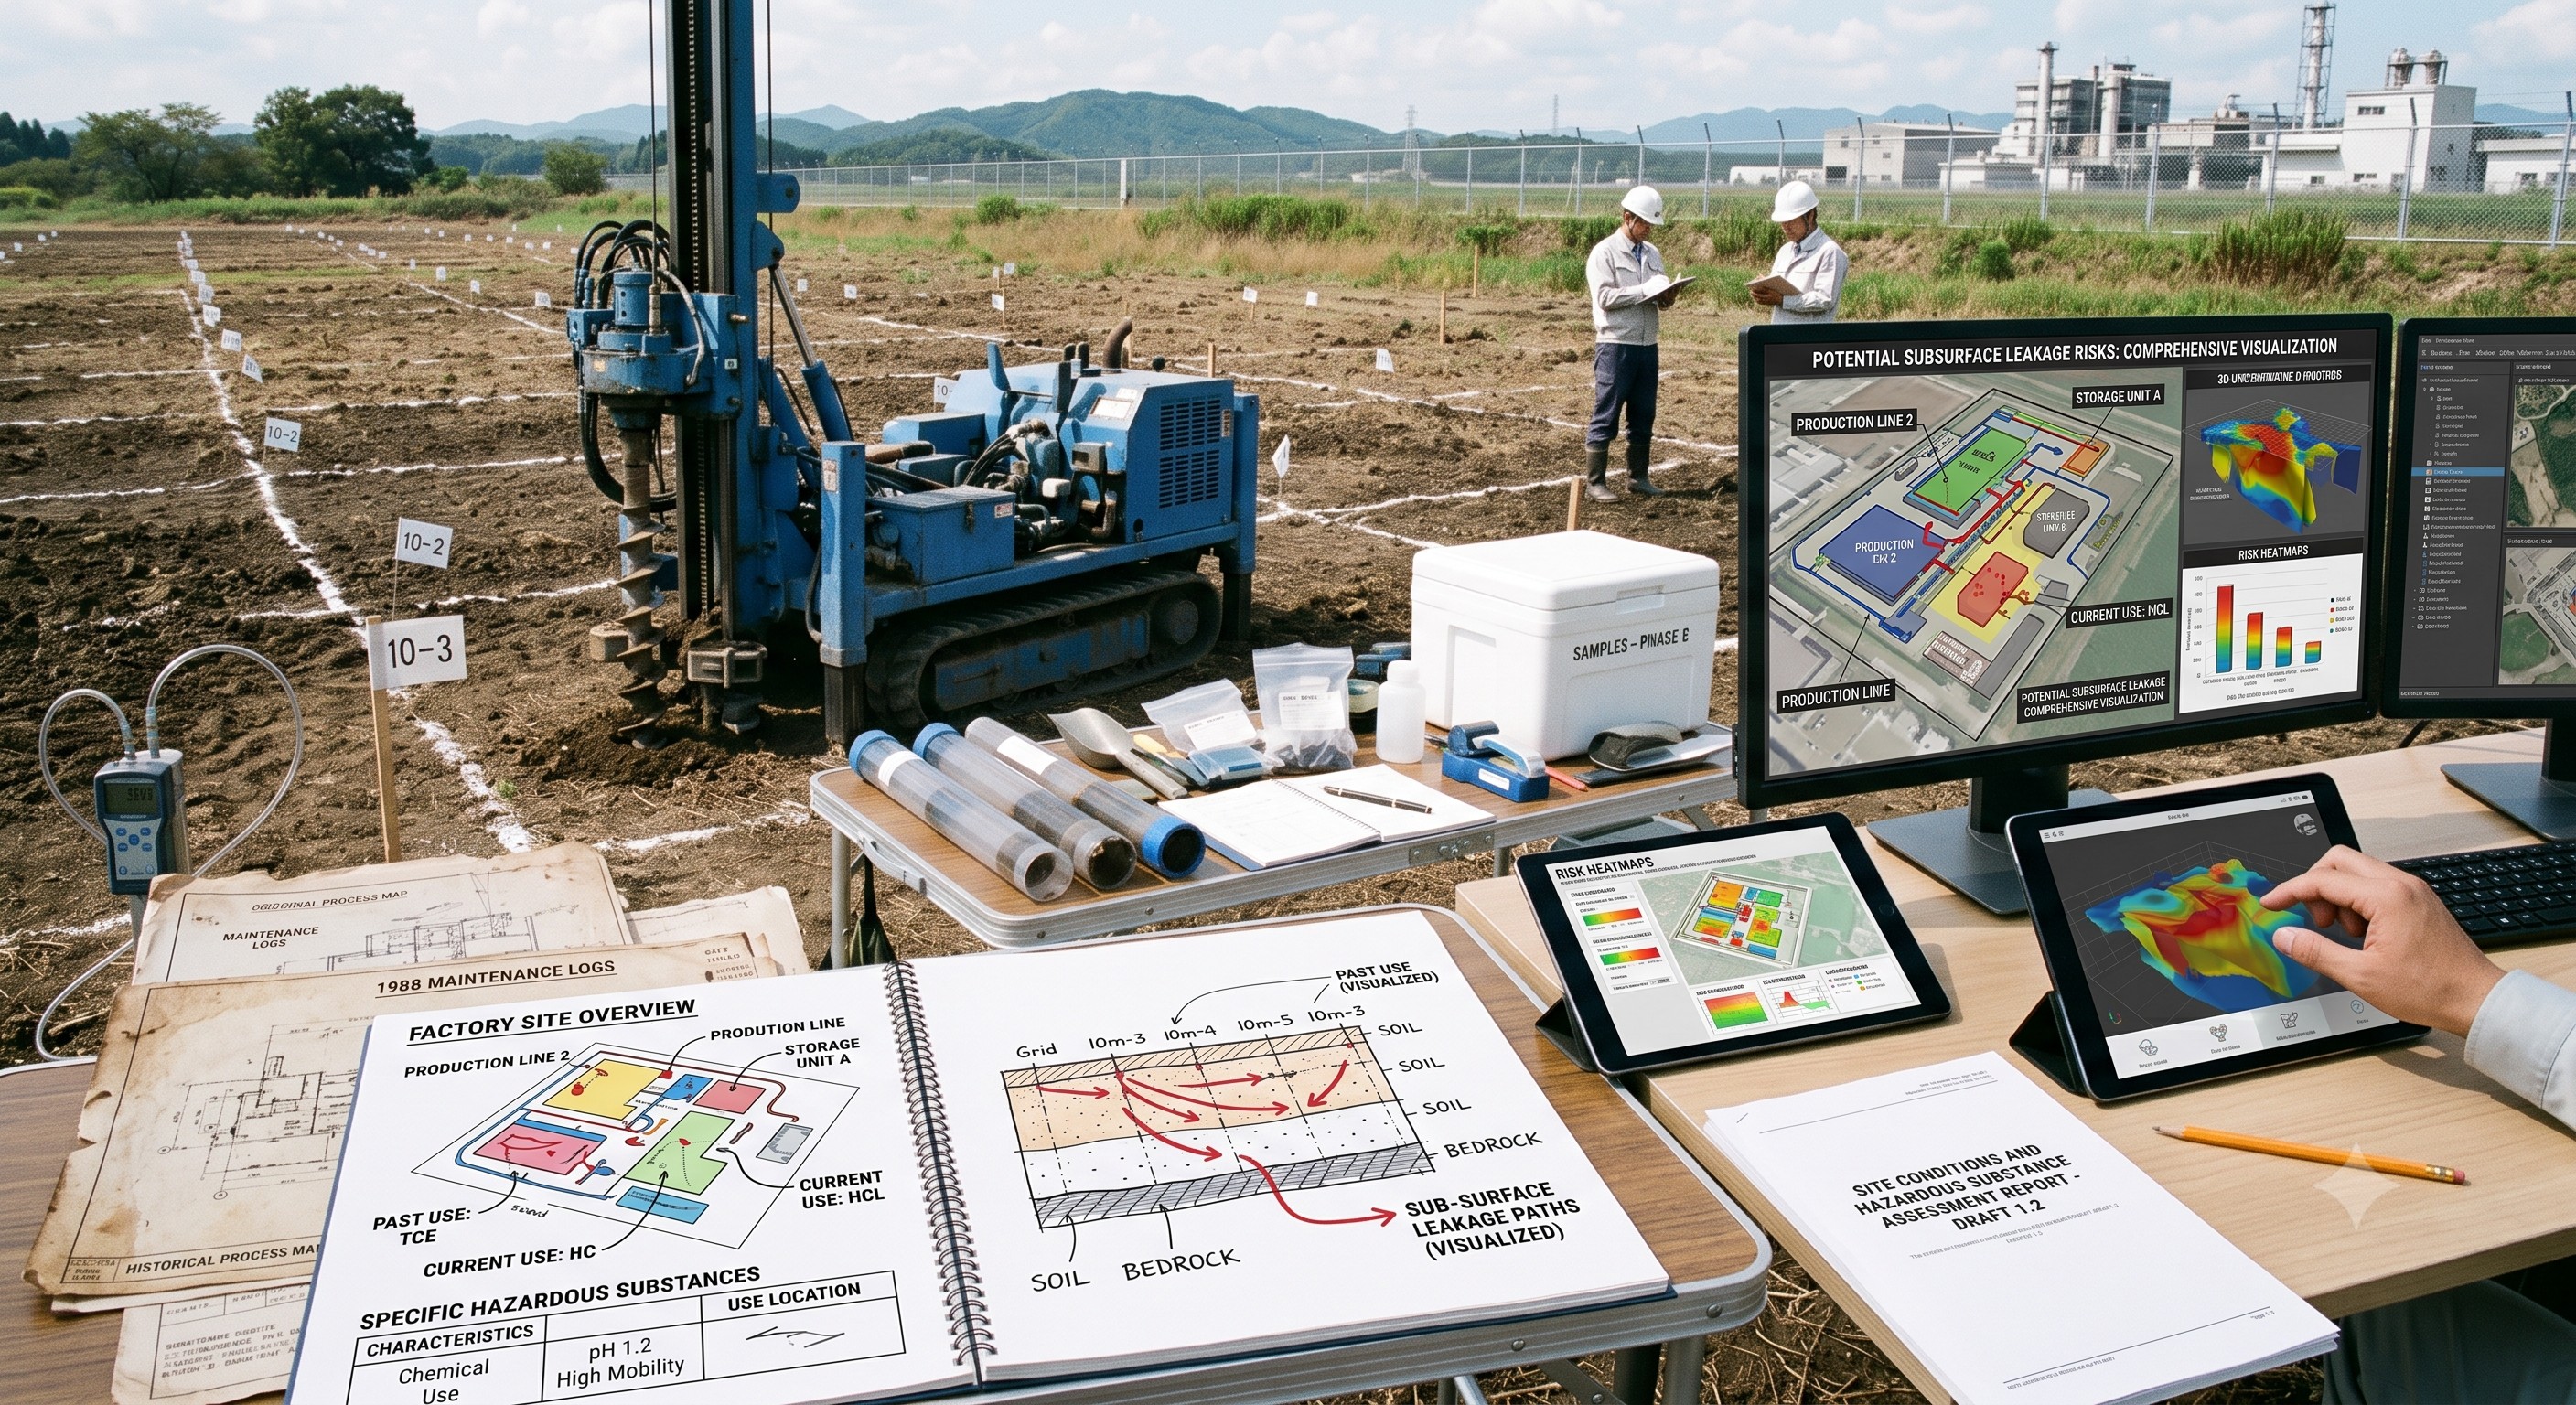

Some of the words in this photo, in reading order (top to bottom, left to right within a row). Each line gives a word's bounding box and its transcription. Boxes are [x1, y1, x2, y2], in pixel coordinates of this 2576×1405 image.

[1812, 349, 1900, 368] POTENTIAL
[1904, 347, 2002, 365] SUBSURFACE
[2005, 345, 2071, 362] LEAKAGE
[2075, 343, 2120, 360] RISKS:
[2123, 341, 2238, 359] COMPREHENSIVE
[2241, 338, 2337, 356] VISUALIZATION
[937, 384, 953, 396] 10-
[2217, 373, 2229, 384] 3D
[2076, 391, 2125, 404] STORAGE
[2127, 390, 2152, 402] UNIT
[2153, 389, 2161, 401] A
[1796, 416, 1874, 431] PRODUCTION
[1877, 414, 1904, 427] LINE
[1905, 413, 1914, 426] 2
[268, 425, 298, 444] 10-2
[403, 531, 445, 556] 10-2
[1855, 539, 1914, 553] PRODUCTION
[2238, 549, 2259, 561] RISK
[2260, 545, 2309, 559] HEATMAPS
[1890, 552, 1897, 563] 2
[2071, 607, 2120, 624] CURRENT
[2121, 606, 2145, 618] USE:
[388, 634, 453, 669] 10-3
[1573, 638, 1628, 661] SAMPLES
[1782, 688, 1860, 709] PRODUCTION
[2022, 689, 2070, 703] POTENTIAL
[2129, 677, 2166, 691] LEAKAGE
[2024, 699, 2098, 718] COMPREHENSIVE
[2100, 691, 2163, 708] VISUALIZATION
[1555, 865, 1586, 880] RISK
[1588, 856, 1655, 875] HEATMAPS
[322, 894, 378, 906] PROCESS
[381, 890, 408, 900] MAP
[222, 926, 319, 941] MAINTENANCE
[252, 938, 286, 949] LOGS
[377, 978, 422, 994] 1988
[427, 965, 563, 989] MAINTENANCE
[568, 960, 616, 976] LOGS
[1335, 965, 1376, 981] PAST
[1379, 960, 1412, 976] USE
[1339, 971, 1440, 994] (VISUALIZED)
[408, 1017, 515, 1042] FACTORY
[521, 1012, 573, 1030] SITE
[578, 999, 696, 1024] OVERVIEW
[710, 1022, 805, 1041] PRODUTION
[810, 1017, 846, 1031] LINE
[1016, 1043, 1057, 1059] Grid
[1089, 1032, 1147, 1050] 10m-3
[1164, 1024, 1217, 1041] 10m-4
[1237, 1014, 1294, 1031] 10m-5
[1307, 1005, 1366, 1023] 10m-3
[1378, 1022, 1423, 1036] SOIL
[784, 1038, 861, 1056] STORAGE
[404, 1056, 515, 1078] PRODUCTION
[519, 1052, 557, 1065] LINE
[560, 1050, 571, 1062] 2
[796, 1055, 835, 1068] UNIT
[839, 1054, 852, 1065] A
[1398, 1057, 1446, 1073] SOIL
[1422, 1099, 1472, 1115] SOIL
[1444, 1132, 1543, 1158] BEDROCK
[800, 1171, 883, 1192] CURRENT
[1852, 1175, 1896, 1196] SITE
[1895, 1153, 2004, 1186] CONDITIONS
[2004, 1143, 2043, 1162] AND
[1853, 1180, 1967, 1216] HAZARDOUS
[1967, 1154, 2072, 1188] SUBSTANCE
[801, 1195, 843, 1209] USE:
[848, 1187, 886, 1205] HCL
[1404, 1181, 1555, 1217] SUB-SURFACE
[1881, 1190, 1999, 1229] ASSESSMENT
[1999, 1173, 2070, 1199] REPORT
[372, 1212, 424, 1231] PAST
[428, 1207, 471, 1224] USE:
[1412, 1210, 1509, 1238] LEAKAGE
[1508, 1198, 1581, 1222] PATHS
[1951, 1206, 2013, 1231] DRAFT
[2013, 1198, 2047, 1216] 1.2
[400, 1228, 437, 1246] TCE
[1425, 1222, 1565, 1261] (VISUALIZED)
[125, 1255, 216, 1275] HISTORICAL
[220, 1248, 288, 1264] PROCESS
[424, 1253, 516, 1278] CURRENT
[521, 1248, 564, 1266] USE:
[569, 1244, 596, 1260] HC
[1031, 1271, 1091, 1292] SOIL
[1122, 1248, 1241, 1281] BEDROCK
[360, 1303, 465, 1331] SPECIFIC
[470, 1284, 610, 1317] HAZARDOUS
[616, 1266, 761, 1297] SUBSTANCES
[728, 1294, 765, 1312] USE
[768, 1282, 862, 1309] LOCATION
[366, 1324, 535, 1357] CHARACTERISTICS
[588, 1339, 617, 1364] pH
[622, 1336, 652, 1357] 1.2
[398, 1357, 490, 1386] Chemical
[556, 1366, 602, 1392] High
[607, 1357, 685, 1382] Mobility
[422, 1387, 460, 1405] Use
